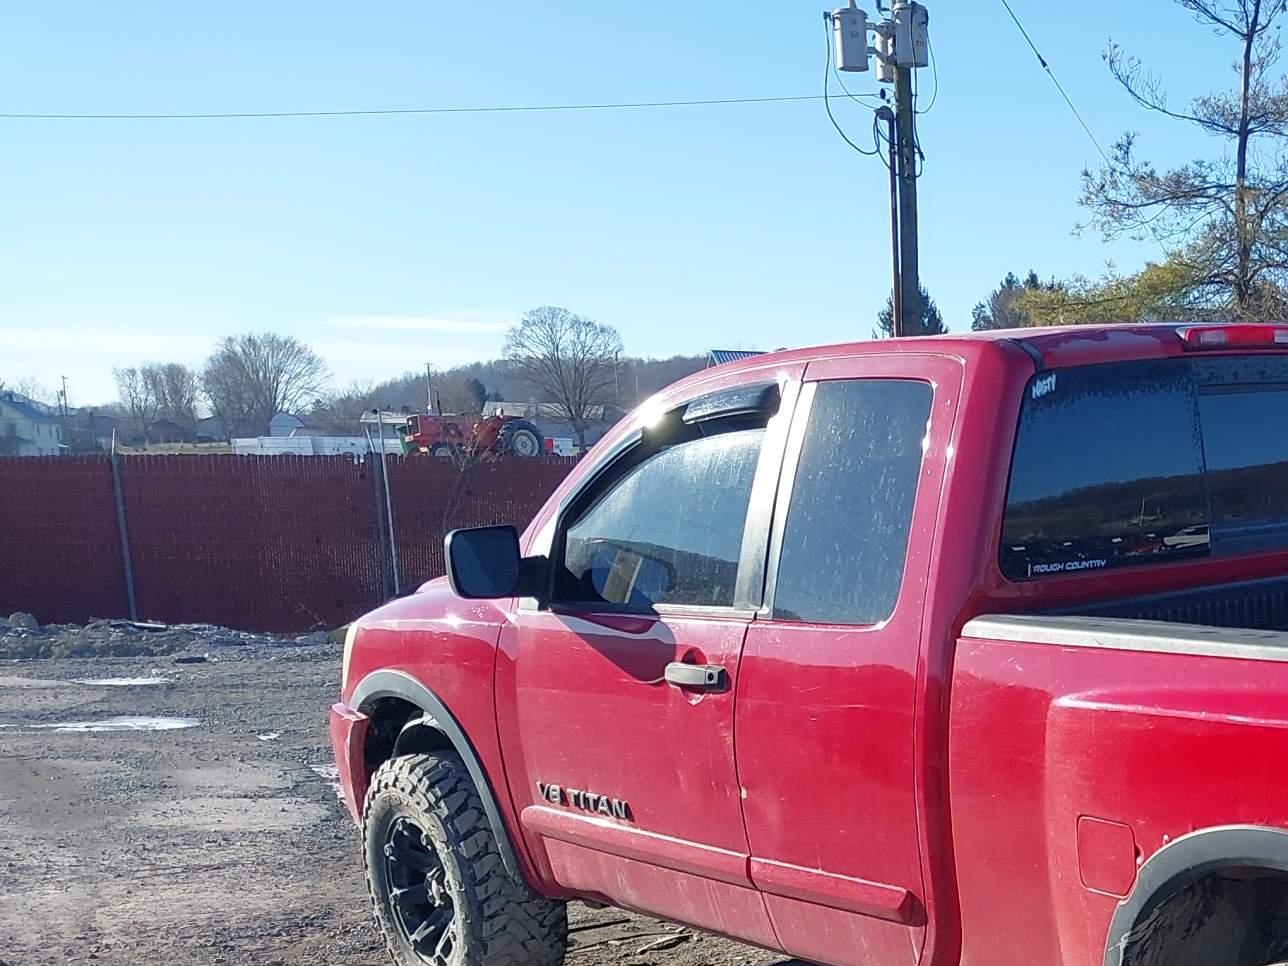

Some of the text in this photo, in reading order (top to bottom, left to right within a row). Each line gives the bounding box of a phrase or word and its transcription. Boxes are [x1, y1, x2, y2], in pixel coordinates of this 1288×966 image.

[1032, 559, 1107, 574] ROUGH COUNTRY
[536, 781, 631, 821] V8 TITAN
